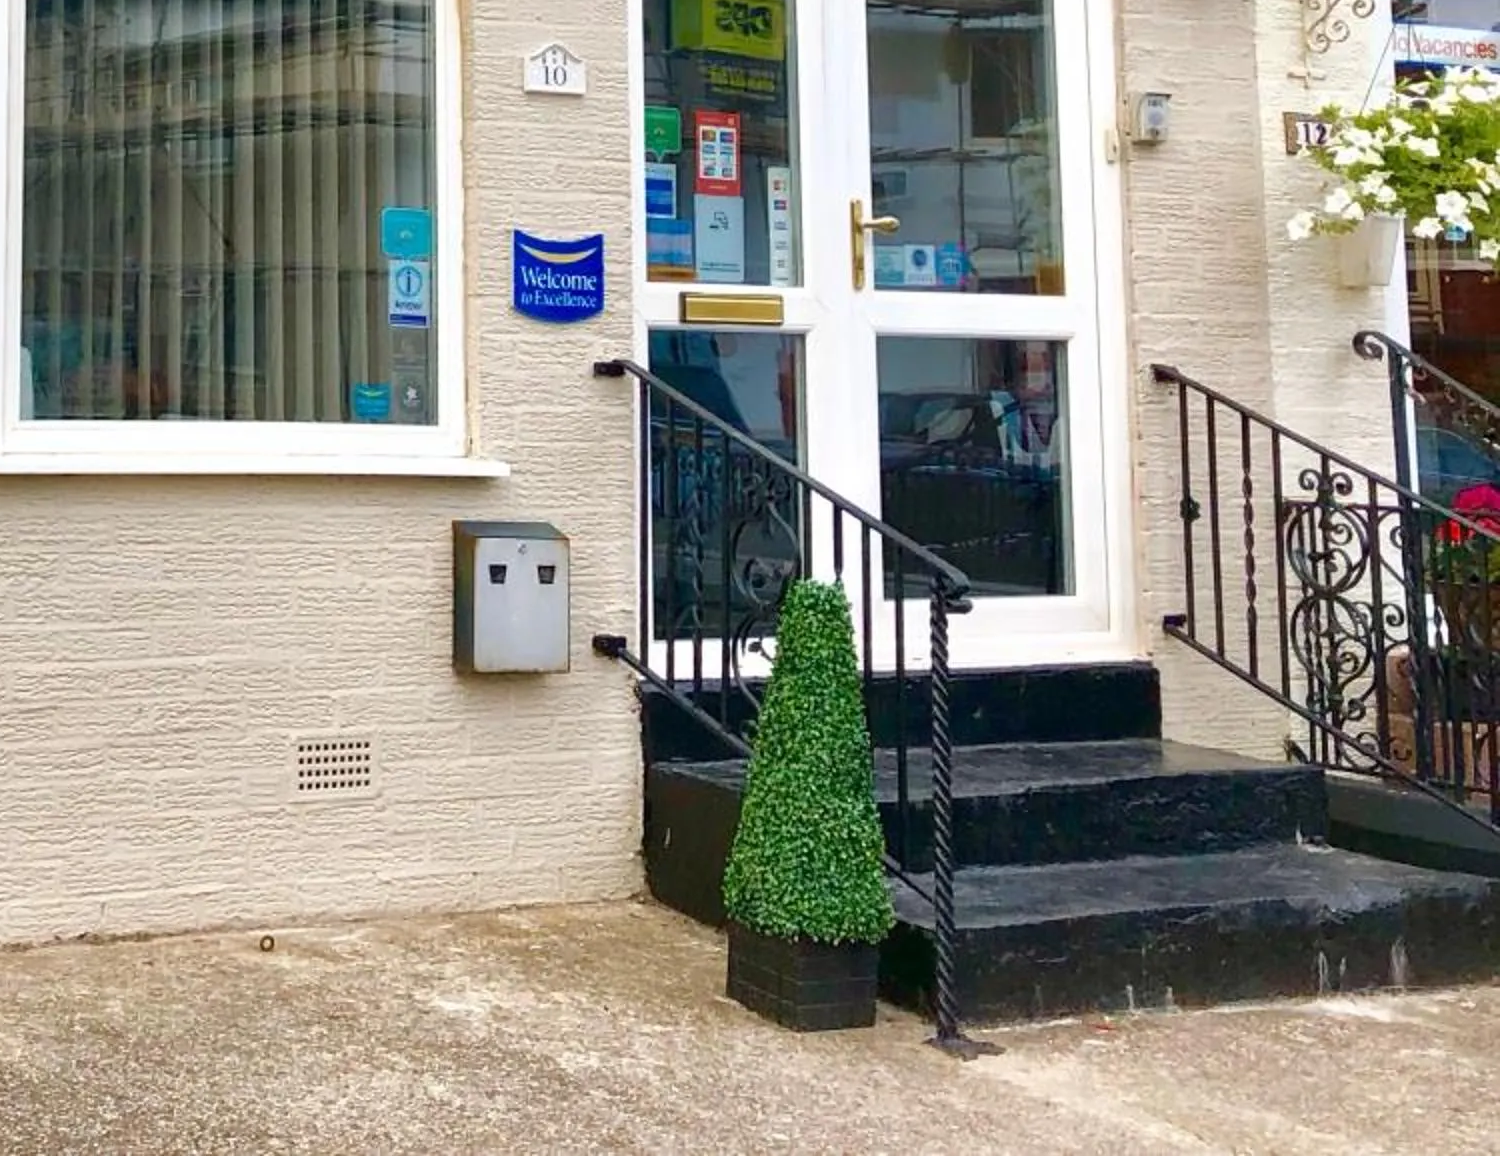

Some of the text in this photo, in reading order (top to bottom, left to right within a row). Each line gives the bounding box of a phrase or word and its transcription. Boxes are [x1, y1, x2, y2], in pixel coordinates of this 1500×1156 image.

[1411, 30, 1497, 60] Vacancies
[544, 65, 567, 86] 10
[1303, 123, 1327, 145] 12
[520, 265, 597, 291] Welcome
[521, 289, 597, 309] to Excellence
